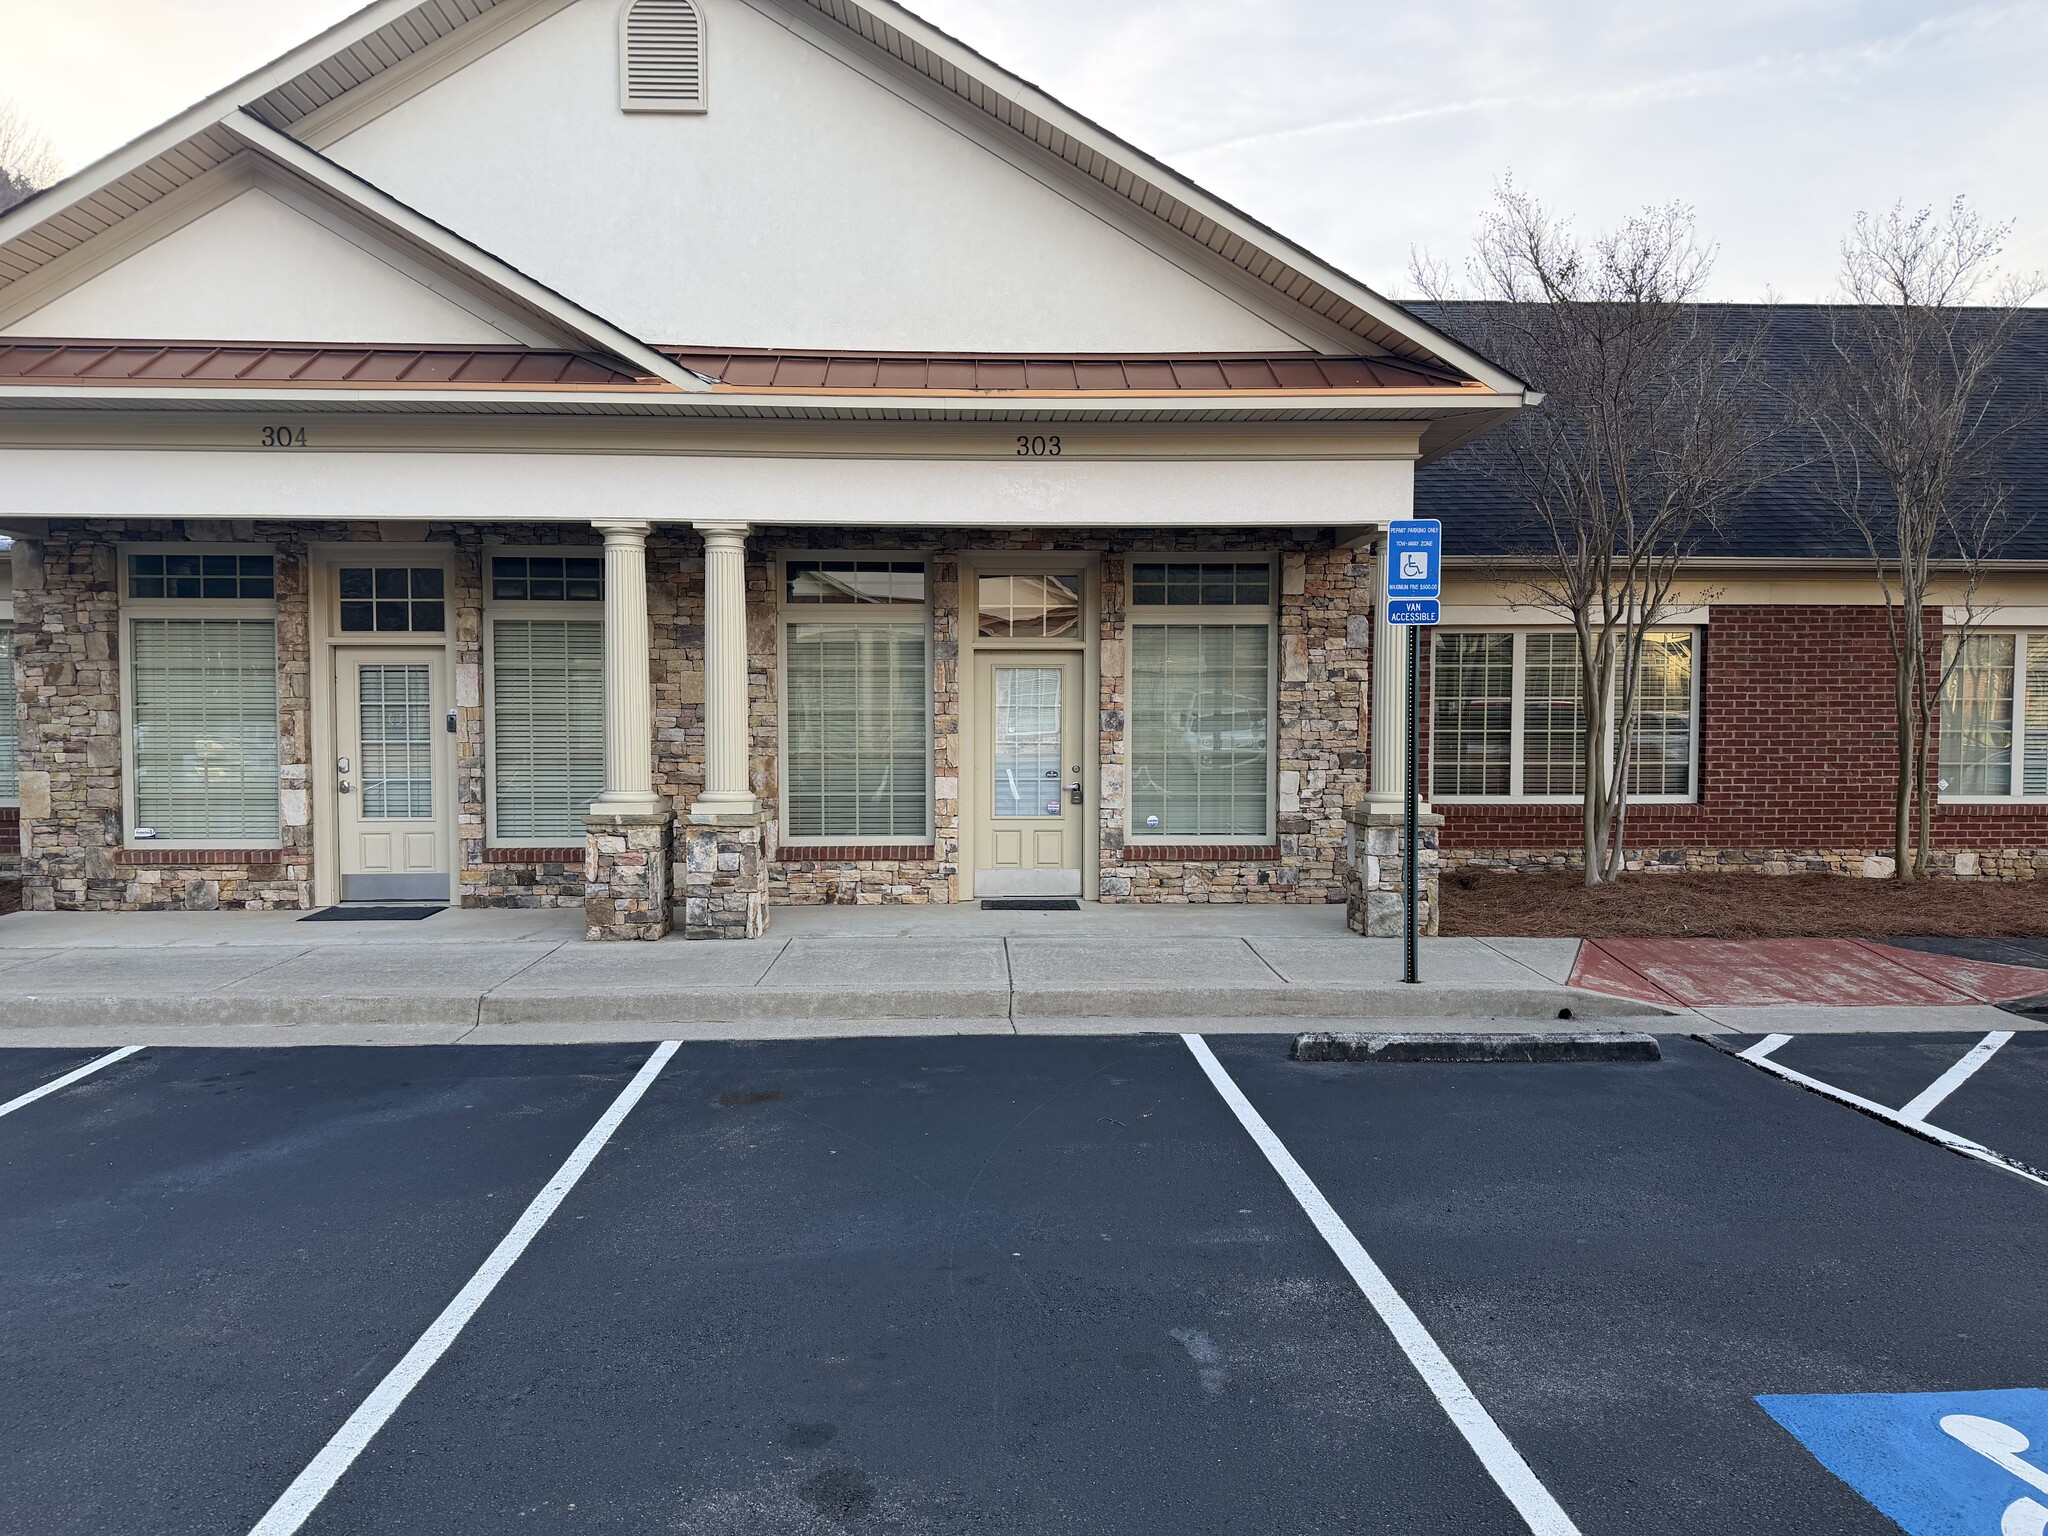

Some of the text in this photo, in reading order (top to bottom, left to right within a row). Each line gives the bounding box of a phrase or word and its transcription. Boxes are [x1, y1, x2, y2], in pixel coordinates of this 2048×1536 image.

[262, 426, 307, 447] 304
[1017, 436, 1061, 456] 303
[1406, 603, 1421, 611] VAN
[1392, 612, 1436, 621] ACCESSIBLE
